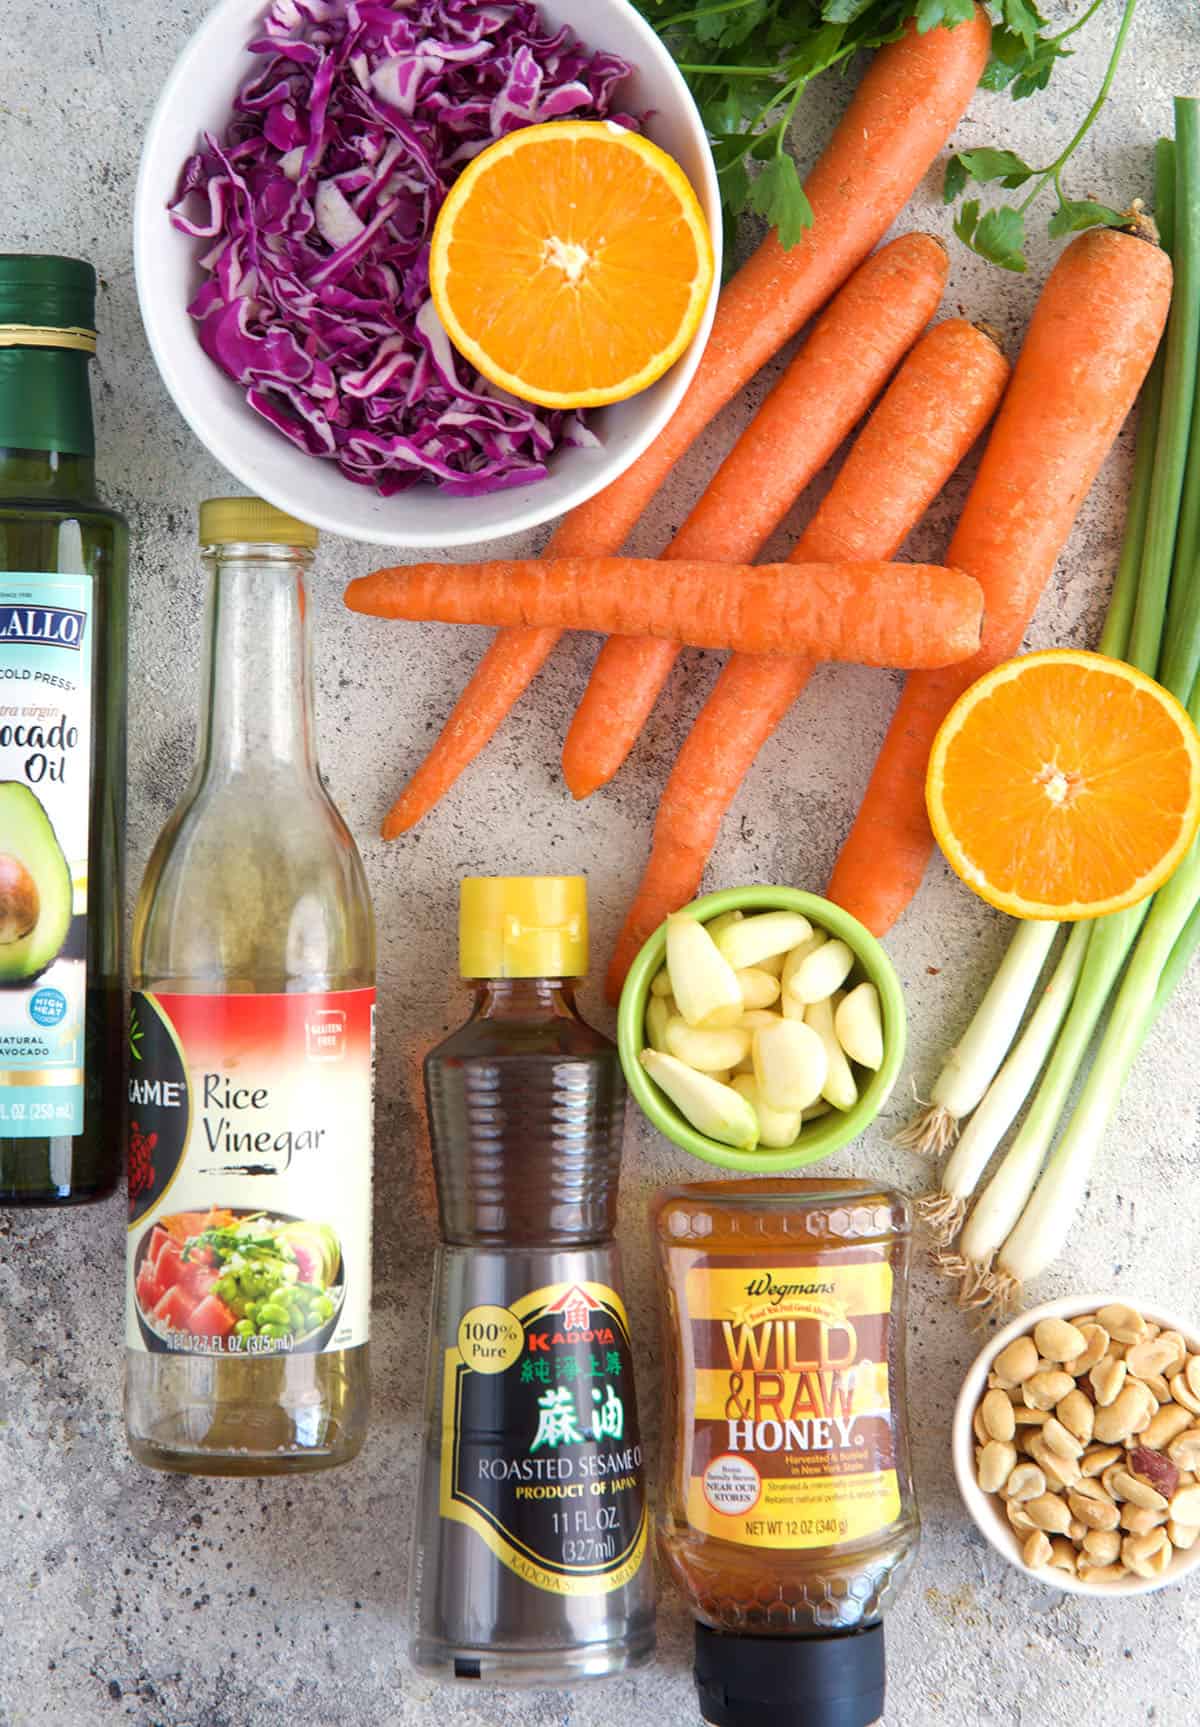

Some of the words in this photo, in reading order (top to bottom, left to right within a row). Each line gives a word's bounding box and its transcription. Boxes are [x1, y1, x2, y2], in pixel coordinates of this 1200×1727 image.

[25, 753, 65, 783] Oil
[34, 1006, 62, 1016] HEAT
[35, 998, 63, 1009] HIGH
[311, 1023, 342, 1034] GLUTEN
[317, 1034, 337, 1046] FREE
[203, 1073, 268, 1110] Rice
[203, 1117, 325, 1169] Vinegar
[745, 1273, 836, 1305] Wegmans
[465, 1323, 518, 1341] 100%
[528, 1328, 615, 1352] KADOYA
[228, 1335, 242, 1351] OZ
[472, 1344, 507, 1358] Pure
[722, 1319, 858, 1372] WILD
[727, 1416, 856, 1452] HONEY
[479, 1458, 574, 1480] ROASTED
[579, 1449, 632, 1477] SESAME
[785, 1454, 830, 1465] Harvested
[801, 1464, 821, 1475] New
[823, 1462, 842, 1474] York
[516, 1485, 584, 1500] PRODUCT
[591, 1483, 606, 1496] OF
[706, 1481, 732, 1492] NEAR
[735, 1482, 757, 1493] OUR
[714, 1493, 751, 1503] STORES
[552, 1513, 569, 1535] 11
[745, 1521, 764, 1536] NET
[767, 1521, 783, 1536] WT
[786, 1521, 798, 1536] 12
[800, 1521, 814, 1536] OZ
[815, 1519, 837, 1535] (340
[838, 1519, 849, 1536] g)
[562, 1535, 616, 1563] (327ml)
